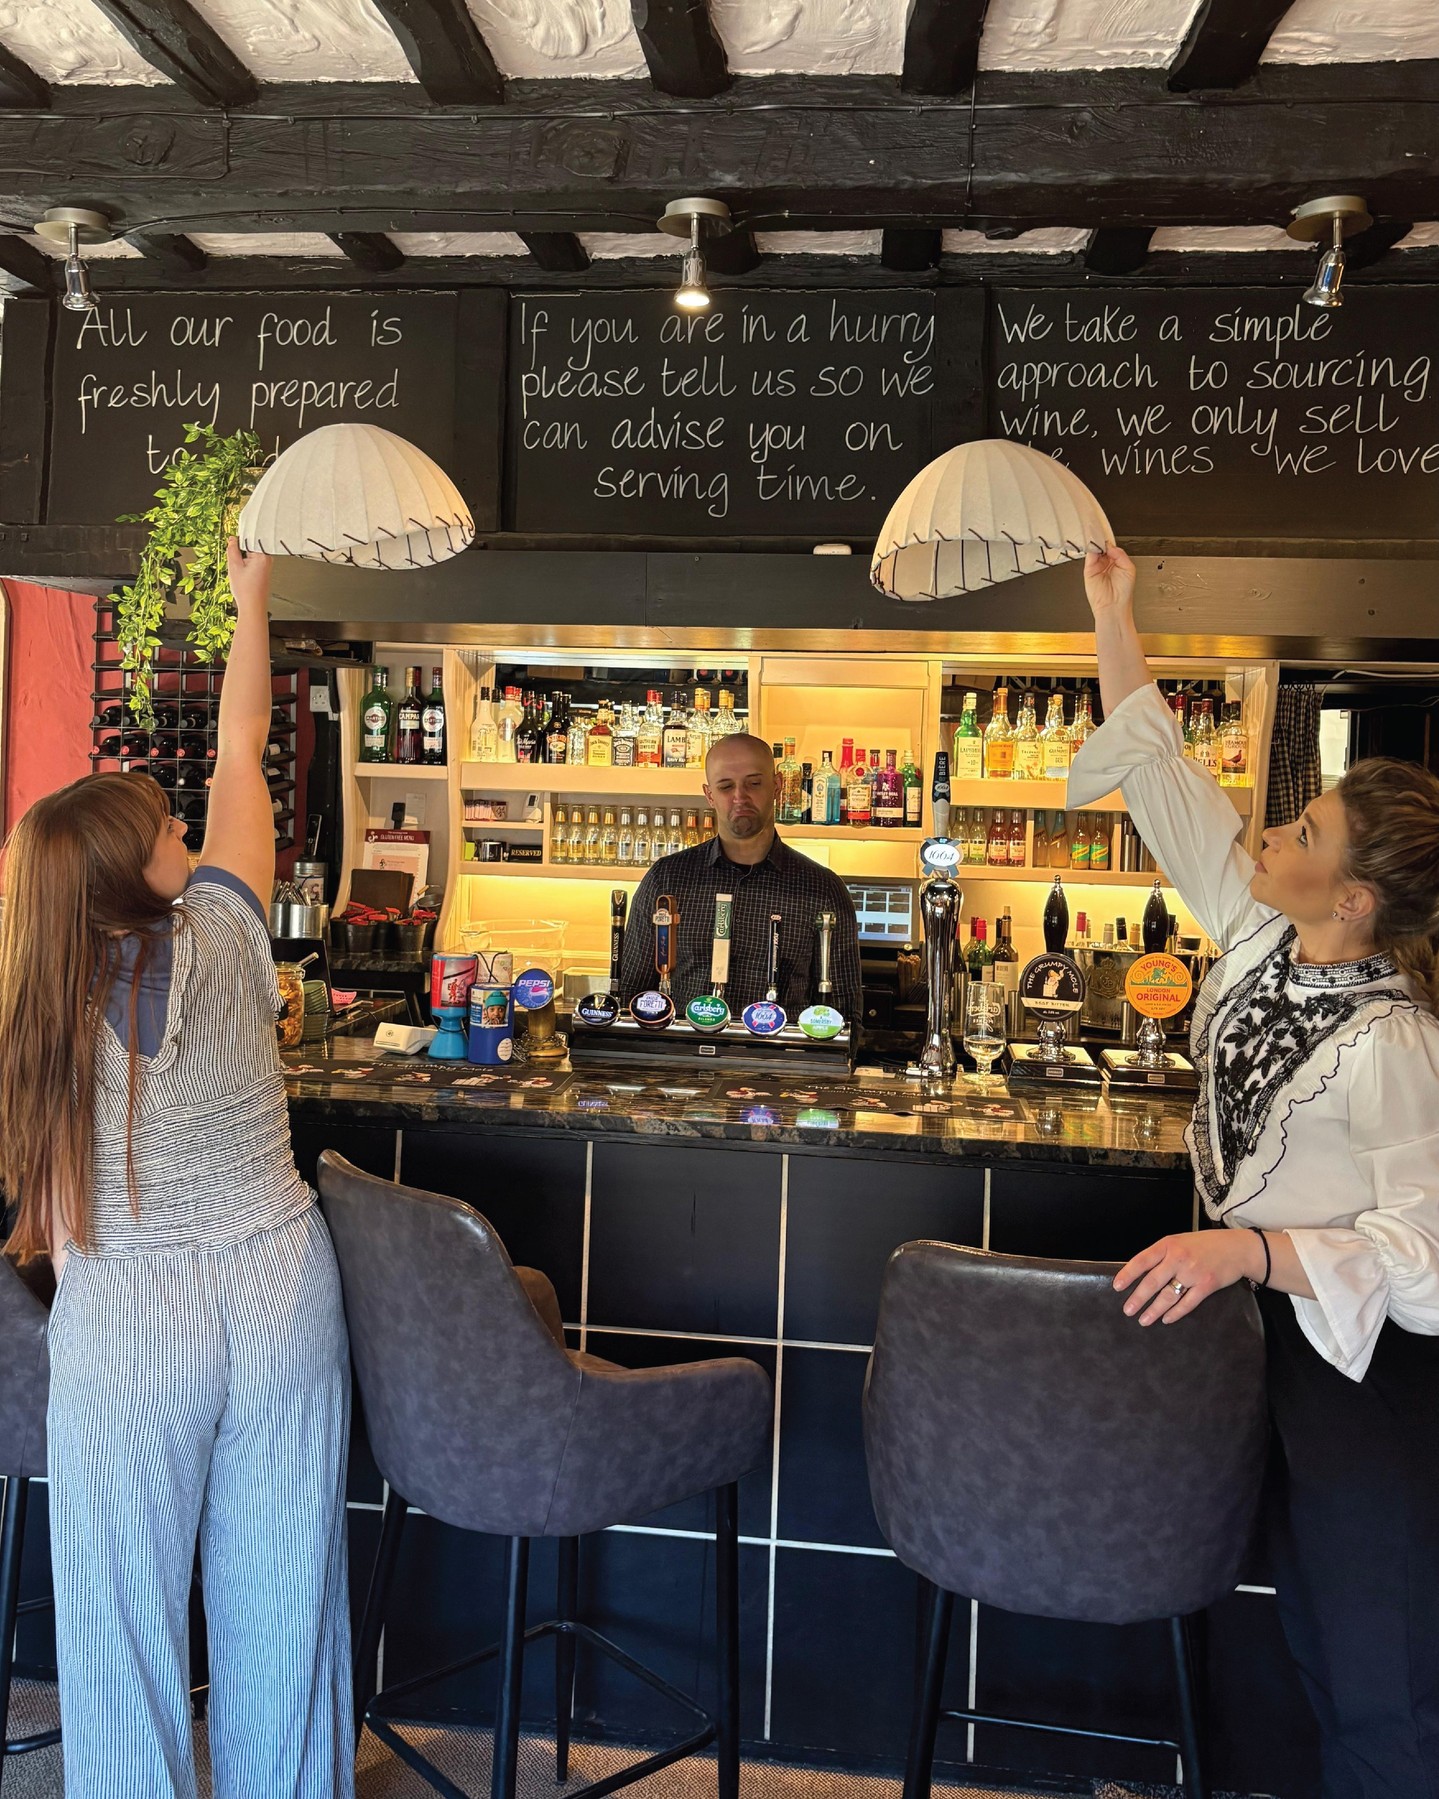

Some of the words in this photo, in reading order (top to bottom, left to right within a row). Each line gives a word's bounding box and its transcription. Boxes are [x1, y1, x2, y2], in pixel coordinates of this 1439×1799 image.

[76, 306, 148, 350] All
[170, 314, 233, 347] our
[258, 306, 337, 371] food
[370, 309, 403, 347] is
[521, 302, 549, 369] If
[567, 321, 638, 371] you
[659, 311, 725, 344] are
[742, 304, 776, 344] in
[787, 311, 811, 343] a
[828, 298, 936, 364] hurry
[998, 303, 1054, 344] We
[1065, 302, 1137, 343] take
[1158, 315, 1182, 342] a
[1208, 304, 1333, 359] simple
[522, 362, 646, 419] please
[661, 355, 737, 397] tell
[751, 367, 796, 396] us
[810, 365, 864, 396] so
[881, 362, 935, 398] we
[998, 352, 1158, 402] approach
[1188, 354, 1229, 391] to
[1246, 350, 1431, 403] sourcing
[78, 368, 220, 435] freshly
[250, 367, 400, 429] prepared
[523, 419, 588, 451] can
[611, 407, 726, 450] advise
[749, 421, 805, 463] you
[845, 420, 903, 451] on
[1000, 402, 1099, 439] wine,
[1117, 403, 1172, 437] we
[1191, 396, 1279, 457] only
[1299, 393, 1399, 434] sell
[1101, 439, 1215, 476] wines
[1274, 444, 1336, 476] we
[1357, 437, 1439, 475] love
[594, 464, 729, 518] serving
[757, 464, 877, 501] time.
[511, 848, 542, 857] RESERVED
[716, 903, 728, 937] Carlsberg
[611, 932, 620, 962] GUINNESS
[1140, 959, 1178, 973] YOUNG'S
[518, 979, 551, 987] PEPSI
[1026, 972, 1036, 990] THE
[1034, 961, 1069, 974] GRUMPY
[1066, 970, 1079, 994] MOLE
[1136, 992, 1181, 1002] ORIGINAL
[581, 1007, 614, 1018] GUINNESS
[690, 1001, 725, 1016] Carlsberg
